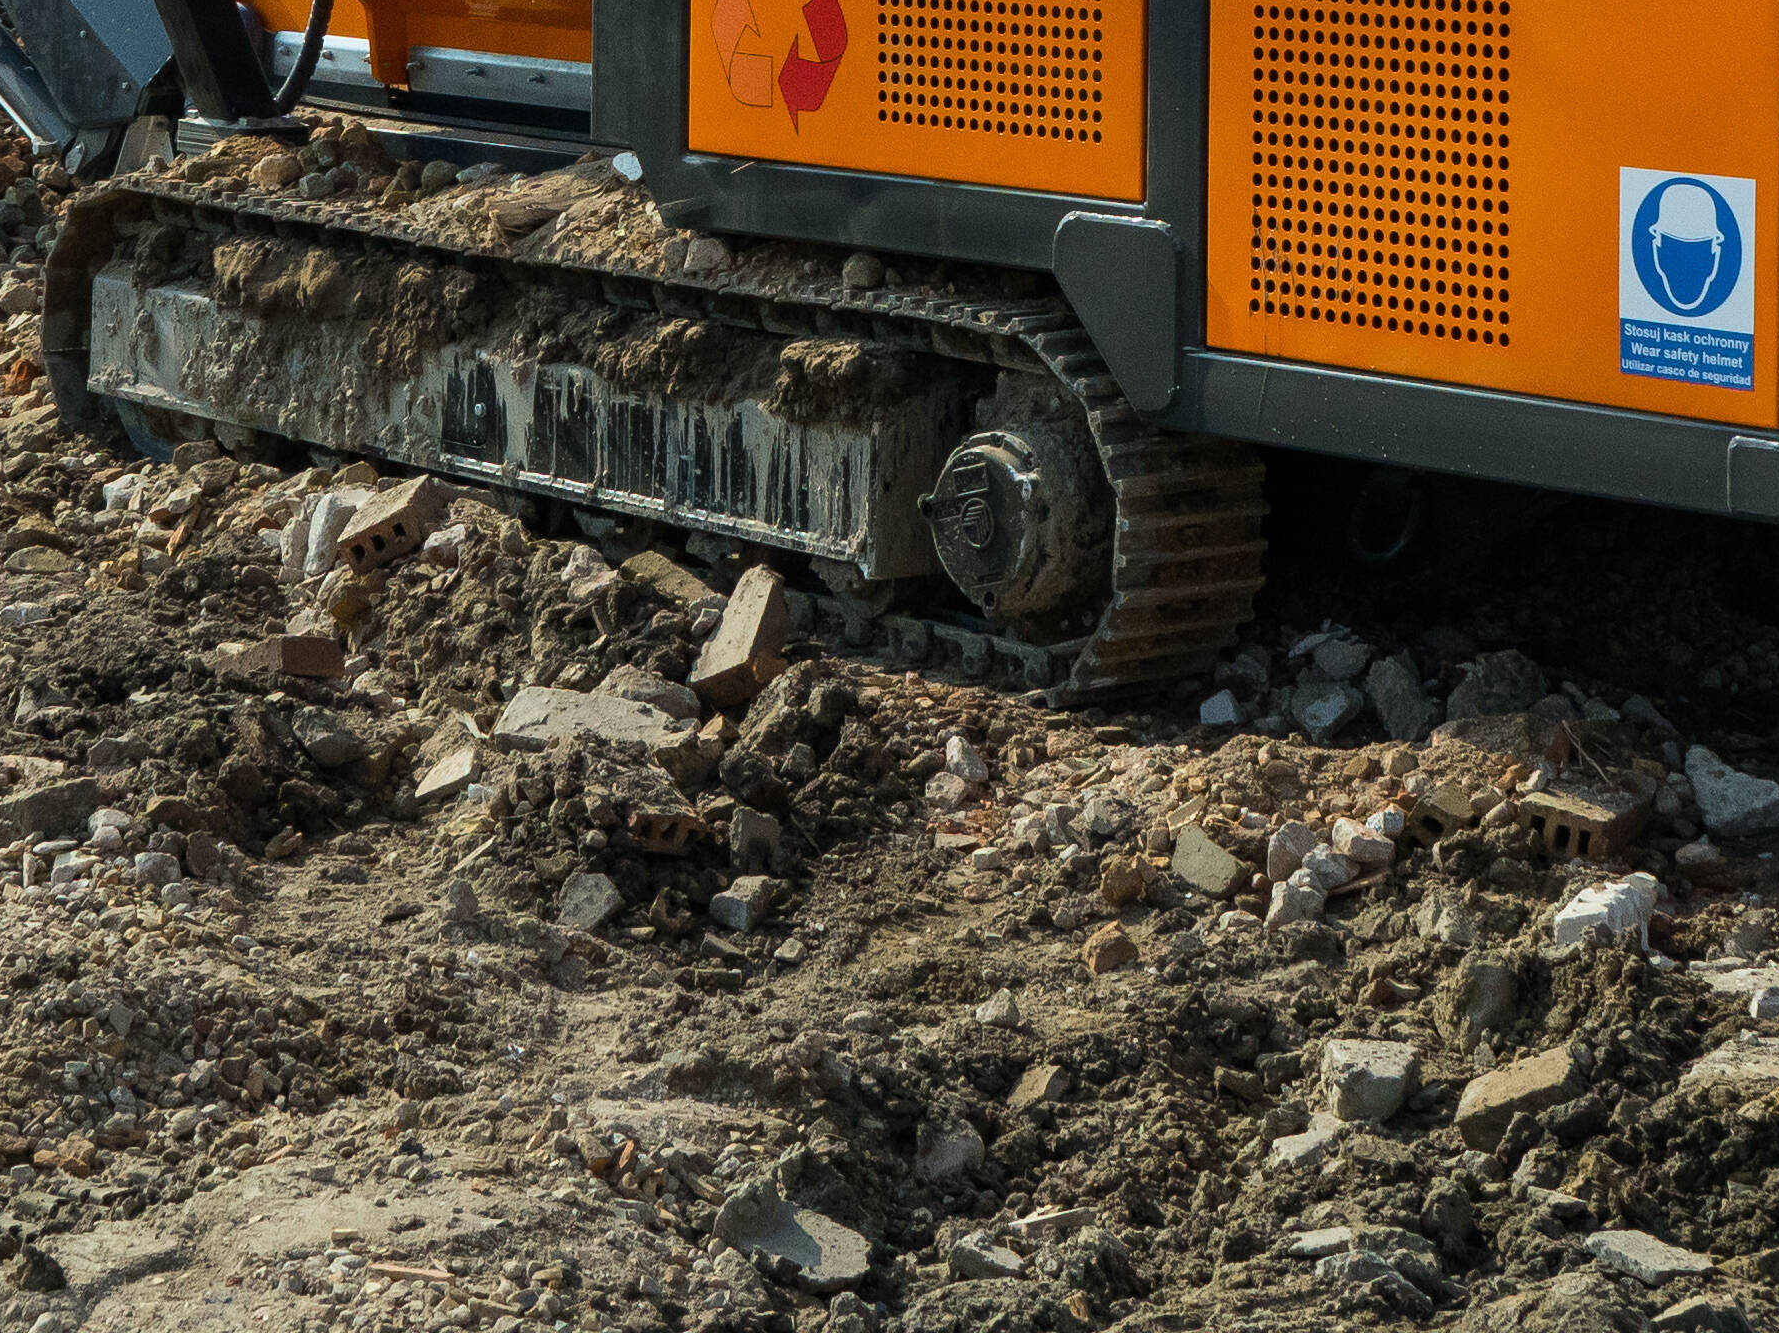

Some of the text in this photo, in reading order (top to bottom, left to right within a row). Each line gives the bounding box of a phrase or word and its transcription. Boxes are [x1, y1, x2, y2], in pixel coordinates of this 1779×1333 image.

[1624, 323, 1750, 354] Stosuj kask ochronny
[1631, 341, 1743, 369] Wear safety helmet
[1621, 358, 1752, 386] Utilizar casco de seguridad
